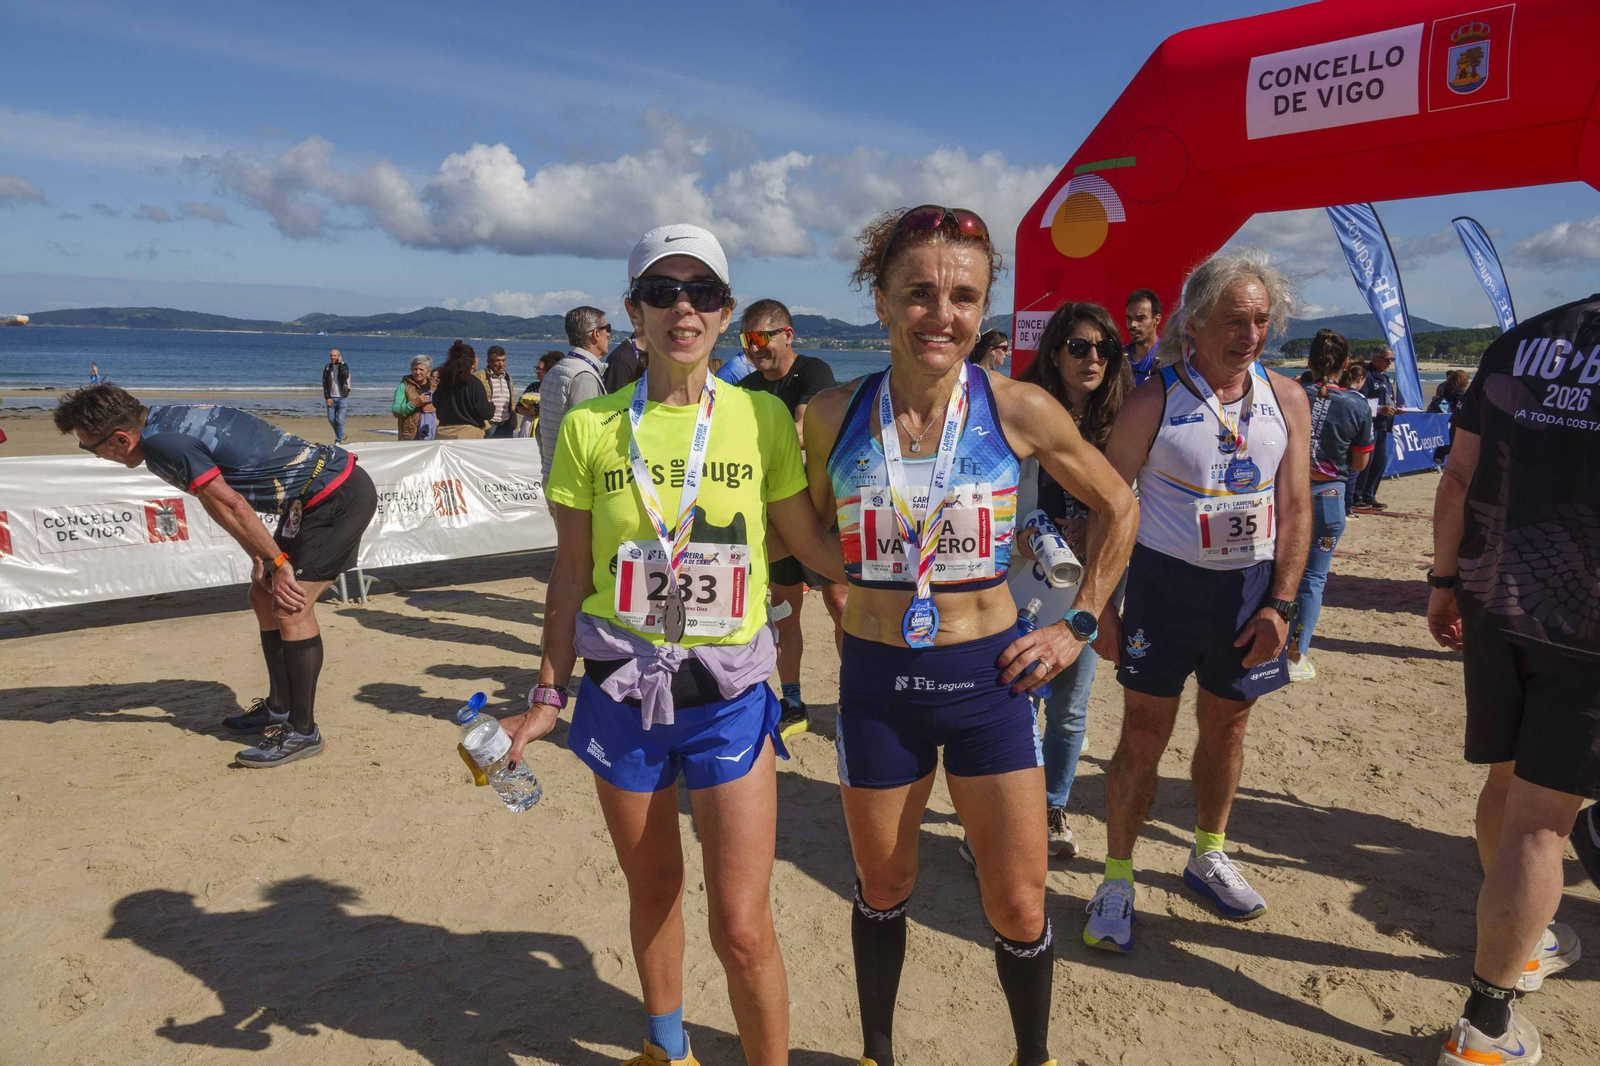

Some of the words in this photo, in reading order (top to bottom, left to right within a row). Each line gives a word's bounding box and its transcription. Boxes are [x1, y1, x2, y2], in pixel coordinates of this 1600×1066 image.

[1258, 45, 1405, 91] CONCELLO
[1274, 90, 1307, 116] DE
[1317, 77, 1385, 108] VIGO
[1017, 319, 1047, 330] CONCEL
[1020, 331, 1029, 341] DE
[1542, 383, 1592, 412] 2026
[1260, 403, 1275, 416] FE
[600, 410, 621, 427] luanvi
[1257, 416, 1281, 424] seguros
[1530, 411, 1564, 426] TODA
[693, 423, 704, 452] CARREIRA
[942, 420, 954, 452] CARREIRA
[1400, 423, 1423, 452] FE
[1421, 435, 1445, 453] seguros
[671, 459, 685, 488] que
[958, 457, 982, 476] FE
[511, 492, 538, 501] VIGO
[43, 511, 132, 529] CONCELLO
[1229, 515, 1257, 537] 35
[56, 530, 79, 542] DE
[86, 526, 125, 539] VIGO
[877, 538, 976, 555] VAERO
[913, 677, 935, 690] FE
[938, 681, 975, 691] seguros
